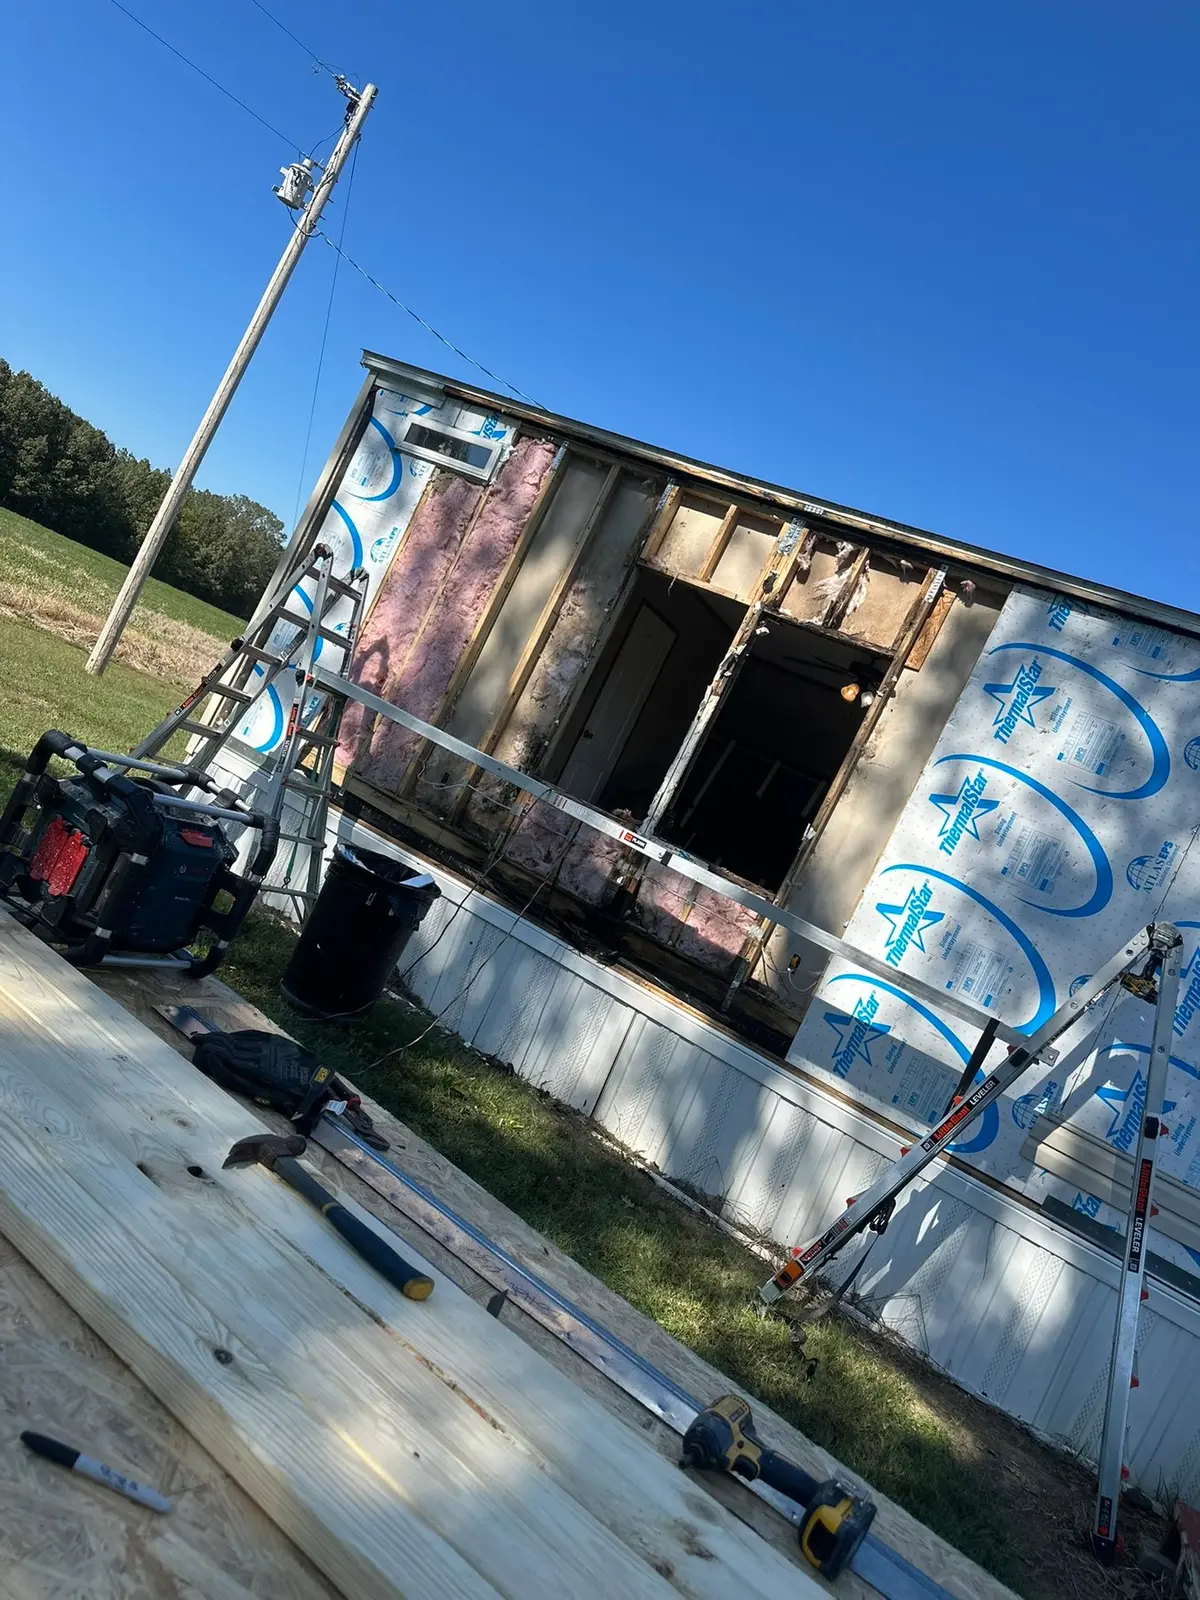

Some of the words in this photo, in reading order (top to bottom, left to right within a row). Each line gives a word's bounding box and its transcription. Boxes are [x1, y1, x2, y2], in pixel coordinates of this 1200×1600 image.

[1143, 859, 1164, 894] ATLAS
[1159, 841, 1173, 860] EPS
[969, 1079, 996, 1105] LEVELER
[1132, 1217, 1143, 1253] LEVELER
